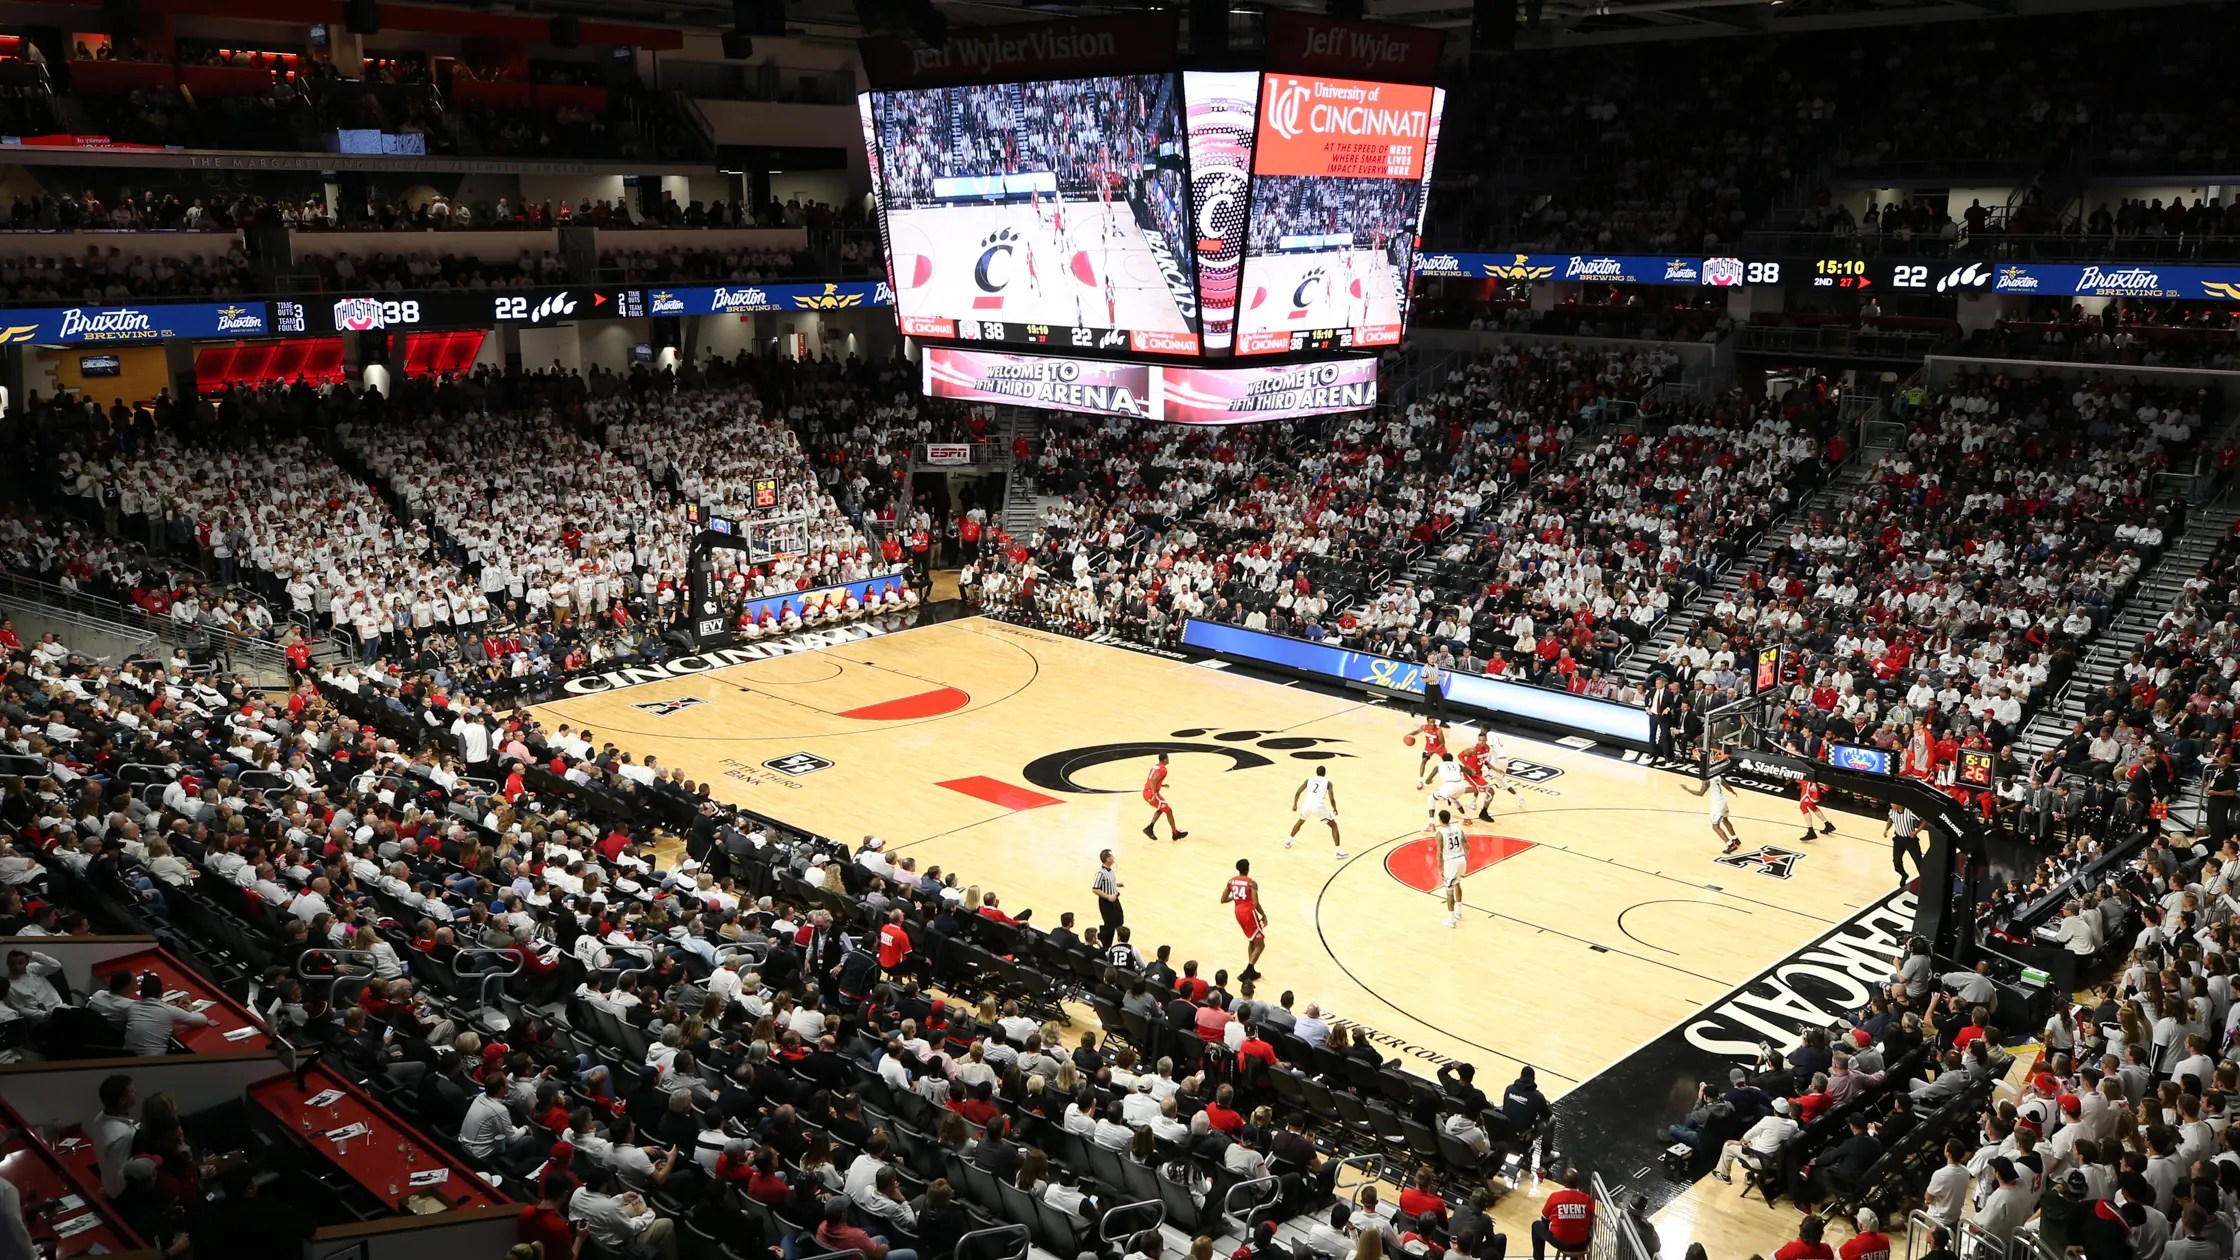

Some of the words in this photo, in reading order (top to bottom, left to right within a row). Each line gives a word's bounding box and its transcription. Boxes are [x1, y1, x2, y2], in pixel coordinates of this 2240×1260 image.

[1302, 26, 1347, 58] Jeff
[1351, 32, 1411, 69] Wyler
[1314, 82, 1367, 103] University
[1368, 87, 1381, 102] of
[1310, 104, 1427, 138] CINCINNATI
[1324, 143, 1334, 151] AT
[1337, 143, 1352, 152] THE
[1353, 144, 1376, 153] SPEED
[1378, 145, 1389, 154] OF
[1389, 145, 1412, 155] NEXT
[191, 157, 221, 167] THE
[232, 158, 322, 169] MARGARET
[333, 160, 363, 169] AND
[1332, 154, 1359, 163] WHERE
[1361, 155, 1386, 164] SMART
[1387, 156, 1412, 165] LIVES
[1327, 164, 1357, 173] IMPACT
[1413, 252, 1459, 271] Braxton
[1565, 256, 1622, 278] Braxton
[1816, 260, 1865, 275] 15:10
[1141, 228, 1196, 318] BEARCATS
[1422, 270, 1462, 278] BREWING
[1579, 274, 1625, 282] BREWING
[1664, 267, 1697, 280] Braxton
[1747, 263, 1780, 283] 38
[1893, 265, 1928, 288] 22
[2076, 266, 2159, 292] Braxton
[1814, 278, 1833, 287] 2ND
[1839, 278, 1853, 287] 27
[1996, 275, 2038, 289] Braxton
[618, 293, 625, 305] 2
[711, 287, 768, 311] Braxton
[2096, 289, 2163, 297] BREWING
[278, 308, 294, 316] OUTS
[293, 304, 303, 318] 3
[383, 300, 420, 323] 38
[495, 297, 528, 319] 22
[618, 305, 626, 317] 4
[652, 299, 684, 313] Braxton
[725, 304, 771, 313] BREWING
[60, 308, 151, 338] Braxton
[217, 315, 262, 331] Braxton
[296, 318, 305, 331] 0
[916, 322, 952, 334] CINCINNATI
[1026, 325, 1049, 335] 15:10
[84, 330, 158, 340] BREWING
[984, 322, 1005, 341] 38
[1071, 327, 1093, 347] 22
[1312, 329, 1333, 340] 15:10
[1366, 331, 1399, 342] CINCINNATI
[1150, 337, 1197, 352] CINCINNATI
[1251, 339, 1289, 350] CINCINNATI
[1290, 338, 1304, 351] 38
[1340, 335, 1353, 347] 22
[986, 362, 1043, 381] WELCOME
[1050, 361, 1080, 382] TO
[1246, 370, 1305, 396] WELCOME
[1309, 363, 1339, 386] TO
[974, 379, 994, 391] FIFTH
[996, 380, 1035, 398] THIRD
[1038, 382, 1143, 418] ARENA
[1227, 397, 1257, 411] FIFTH
[1257, 391, 1295, 411] THIRD
[1300, 380, 1377, 409] ARENA
[930, 448, 967, 458] ESPN
[756, 490, 775, 506] 26
[563, 622, 886, 694] CINCINNATI
[718, 758, 759, 775] FIFTH
[760, 772, 803, 790] THIRD
[724, 769, 765, 786] BANK
[1965, 766, 1984, 782] 26
[1312, 783, 1319, 793] 2
[1939, 812, 1964, 838] SPALDING
[1448, 836, 1460, 850] 34
[1232, 885, 1247, 900] 24
[1113, 952, 1127, 966] 12
[1557, 1203, 1586, 1215] EVENT
[1860, 1250, 1889, 1260] EVENT
